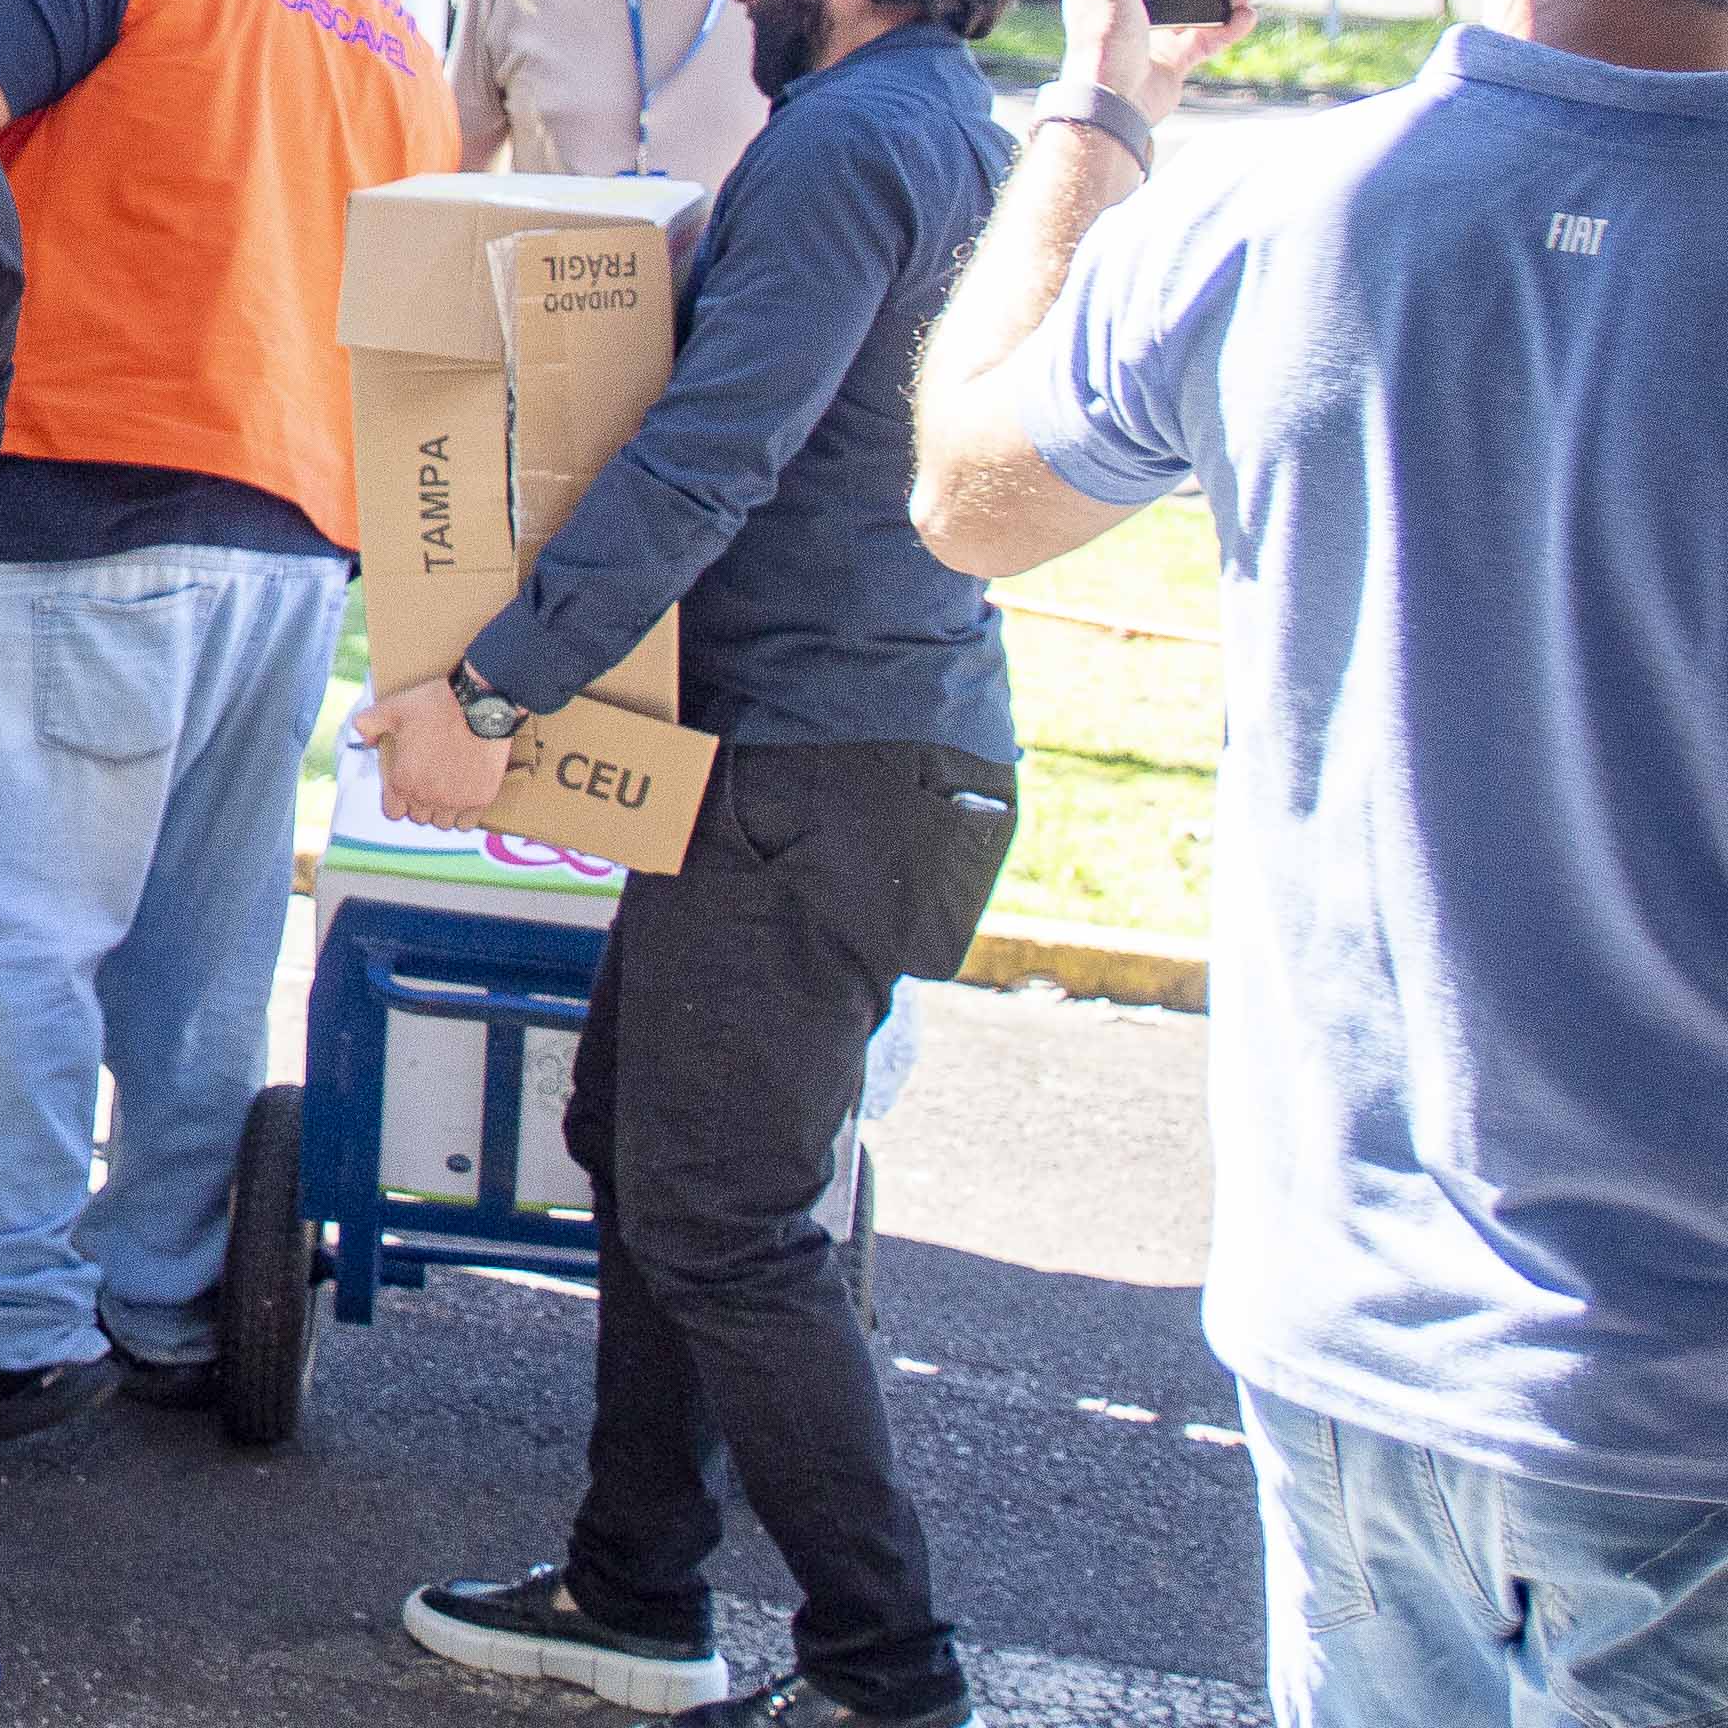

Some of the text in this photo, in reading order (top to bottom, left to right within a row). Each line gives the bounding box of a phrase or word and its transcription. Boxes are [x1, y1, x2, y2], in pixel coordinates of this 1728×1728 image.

[1544, 211, 1609, 257] FIAT
[541, 249, 639, 285] FRÁGIL
[543, 288, 639, 314] CUIDADO
[422, 433, 451, 574] TAMPA
[555, 751, 653, 810] CEU
